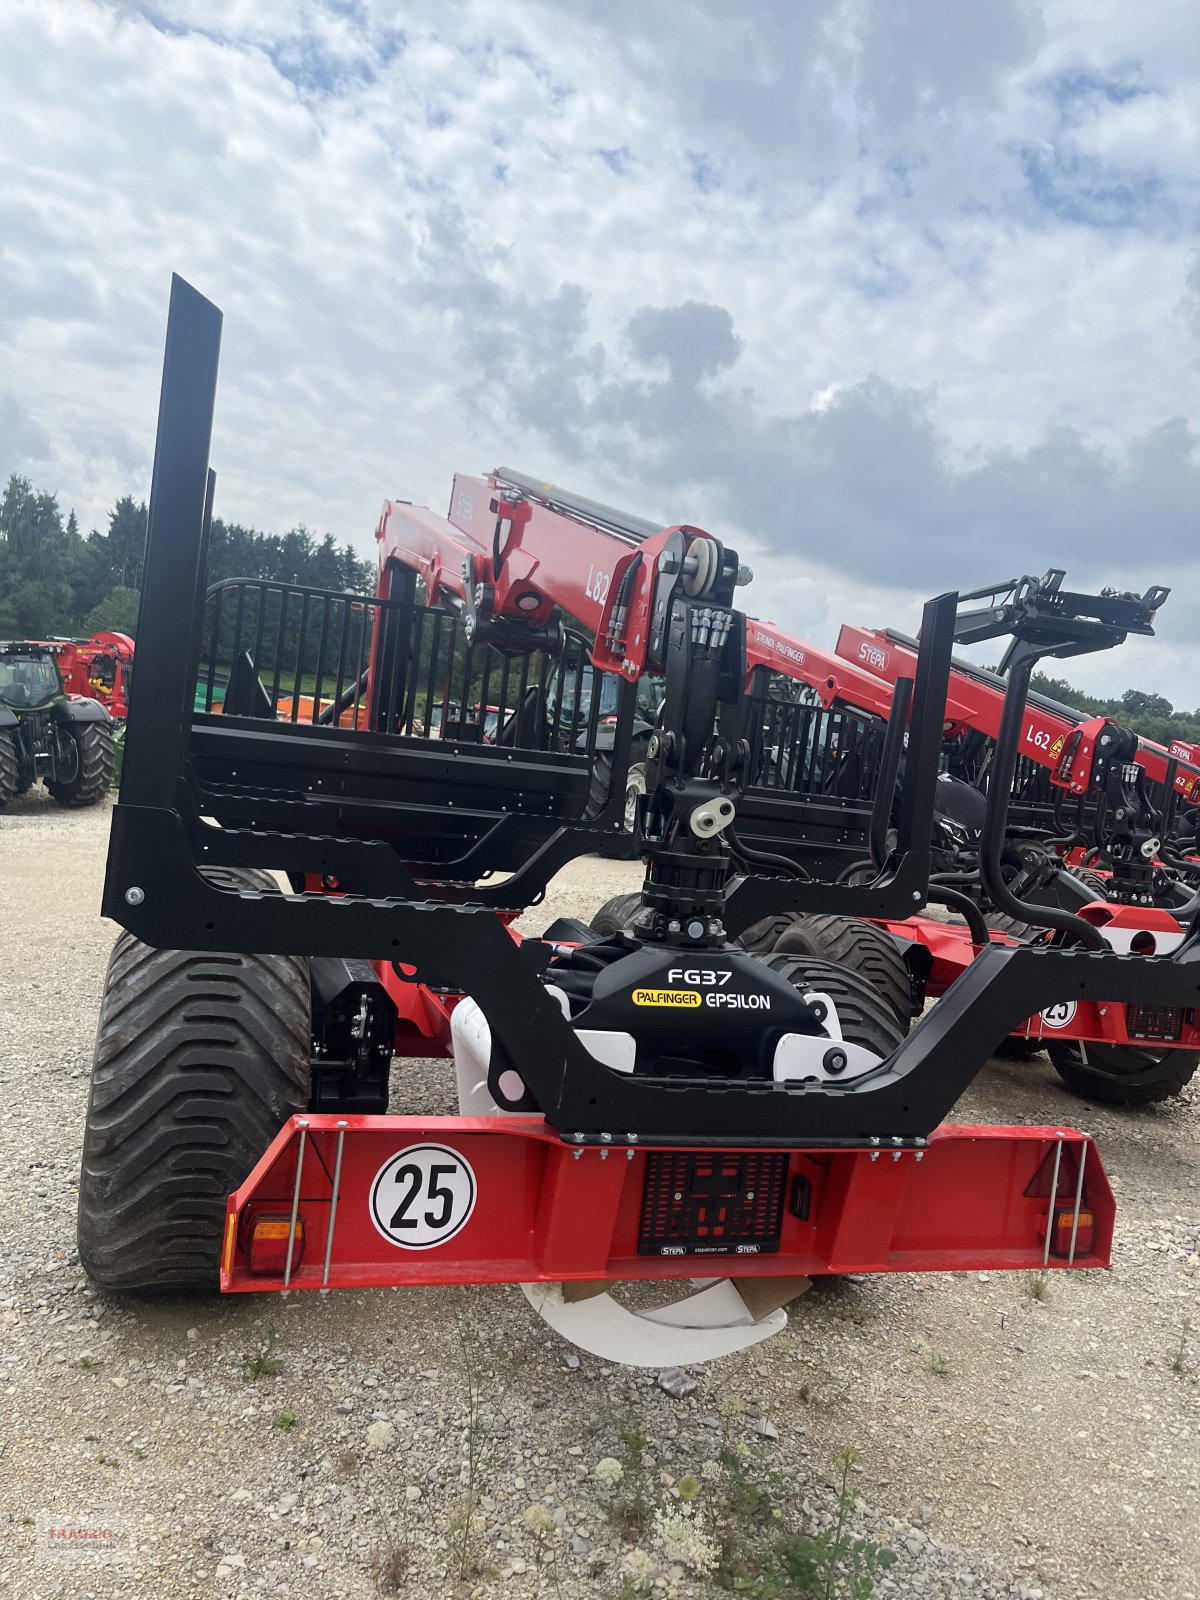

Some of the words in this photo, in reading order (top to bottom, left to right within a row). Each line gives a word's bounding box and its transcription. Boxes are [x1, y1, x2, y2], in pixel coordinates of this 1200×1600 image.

[585, 563, 610, 607] L82
[756, 631, 775, 650] STEINDL
[775, 642, 804, 664] PALFINGER
[859, 641, 886, 670] STEPA
[1026, 724, 1050, 750] L62
[1171, 745, 1191, 761] STEPA
[667, 968, 733, 986] FG37
[636, 991, 698, 1005] PALFINGER
[705, 992, 771, 1009] EPSILON
[389, 1163, 457, 1229] 25
[662, 1246, 685, 1255] STEPA
[736, 1244, 759, 1254] STEPA
